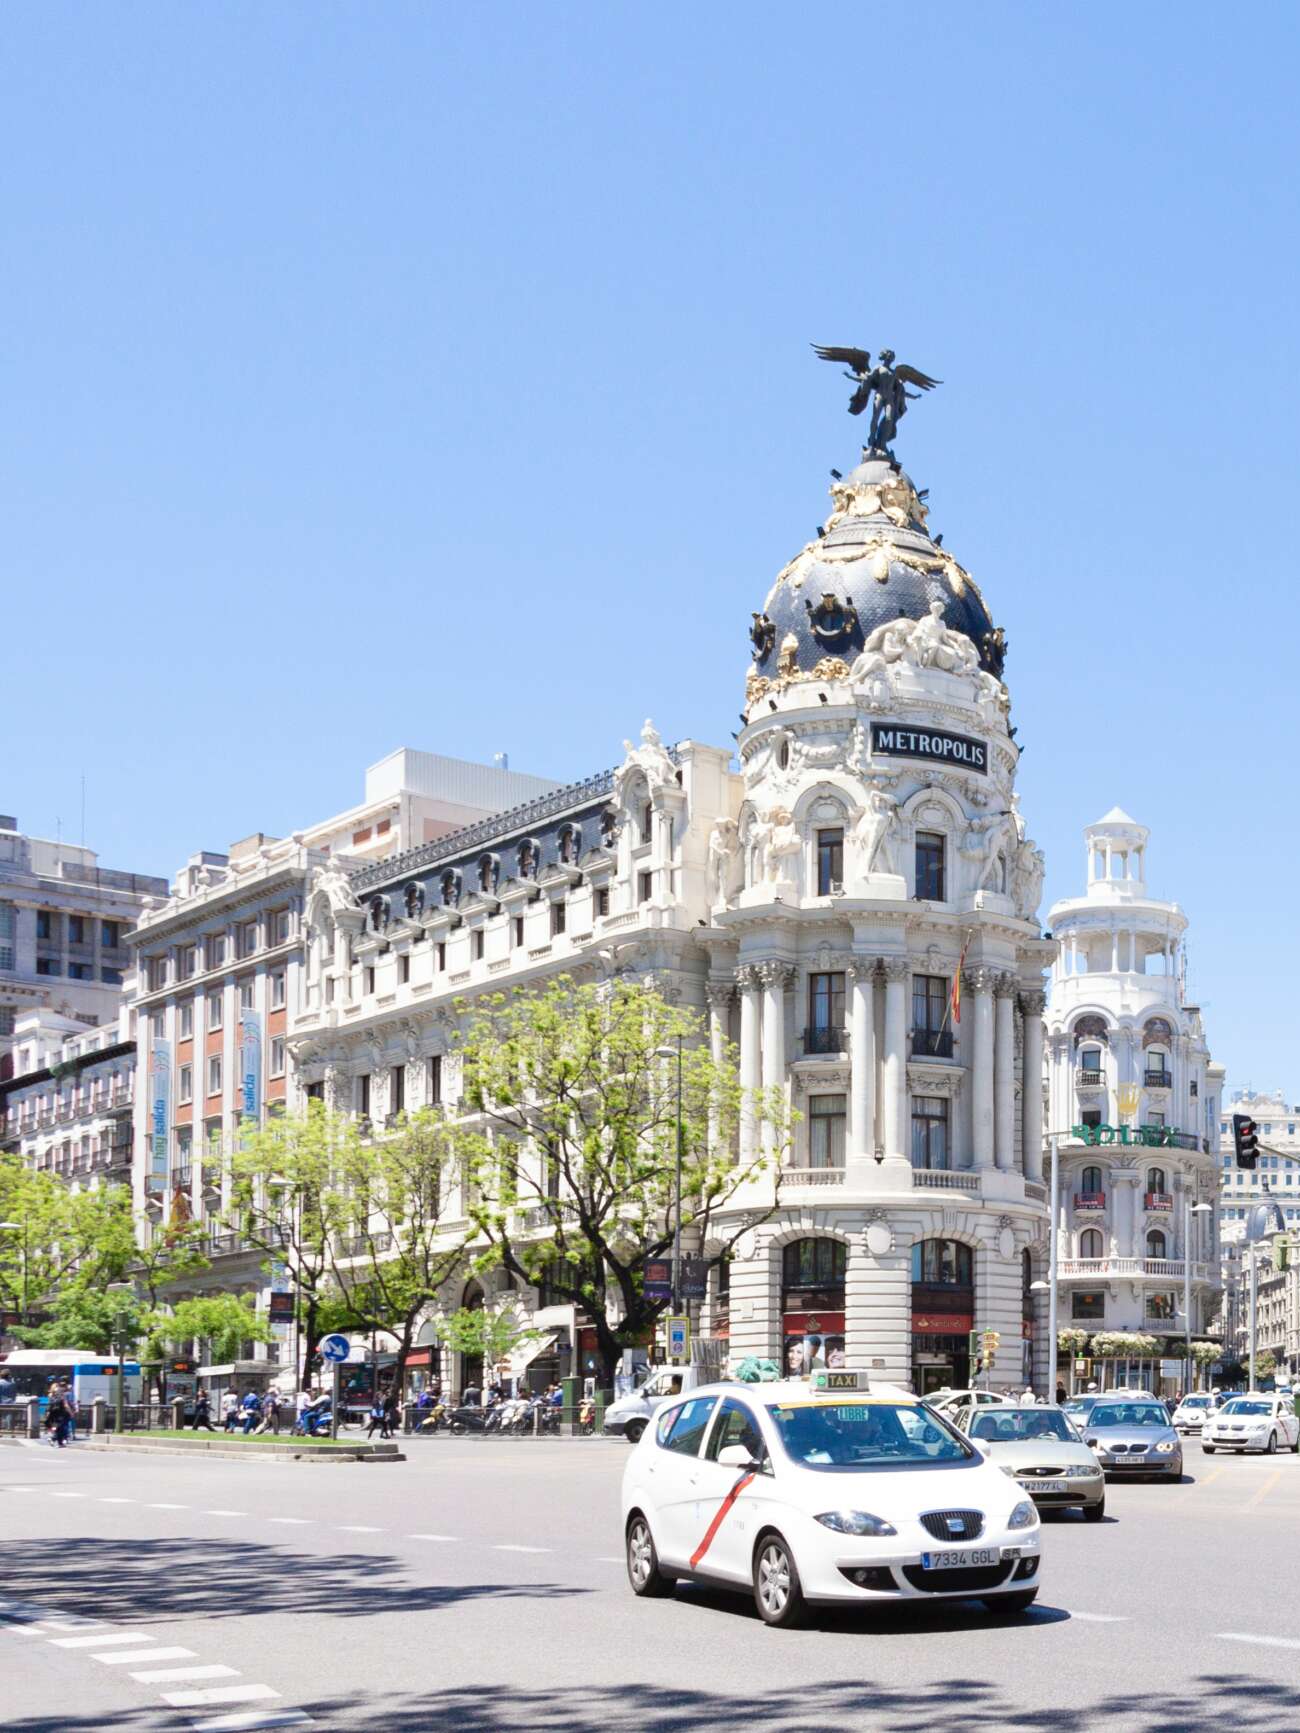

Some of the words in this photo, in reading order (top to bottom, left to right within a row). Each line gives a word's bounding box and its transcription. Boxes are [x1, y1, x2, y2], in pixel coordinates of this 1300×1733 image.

[878, 729, 985, 766] METROPOLIS
[243, 1074, 256, 1111] salida
[153, 1099, 165, 1134] salida
[1071, 1123, 1181, 1147] ROLEX
[153, 1136, 168, 1160] hay
[829, 1375, 857, 1387] TAXI
[838, 1407, 868, 1421] LIBRE
[933, 1552, 967, 1567] 7334
[971, 1550, 995, 1565] GGL
